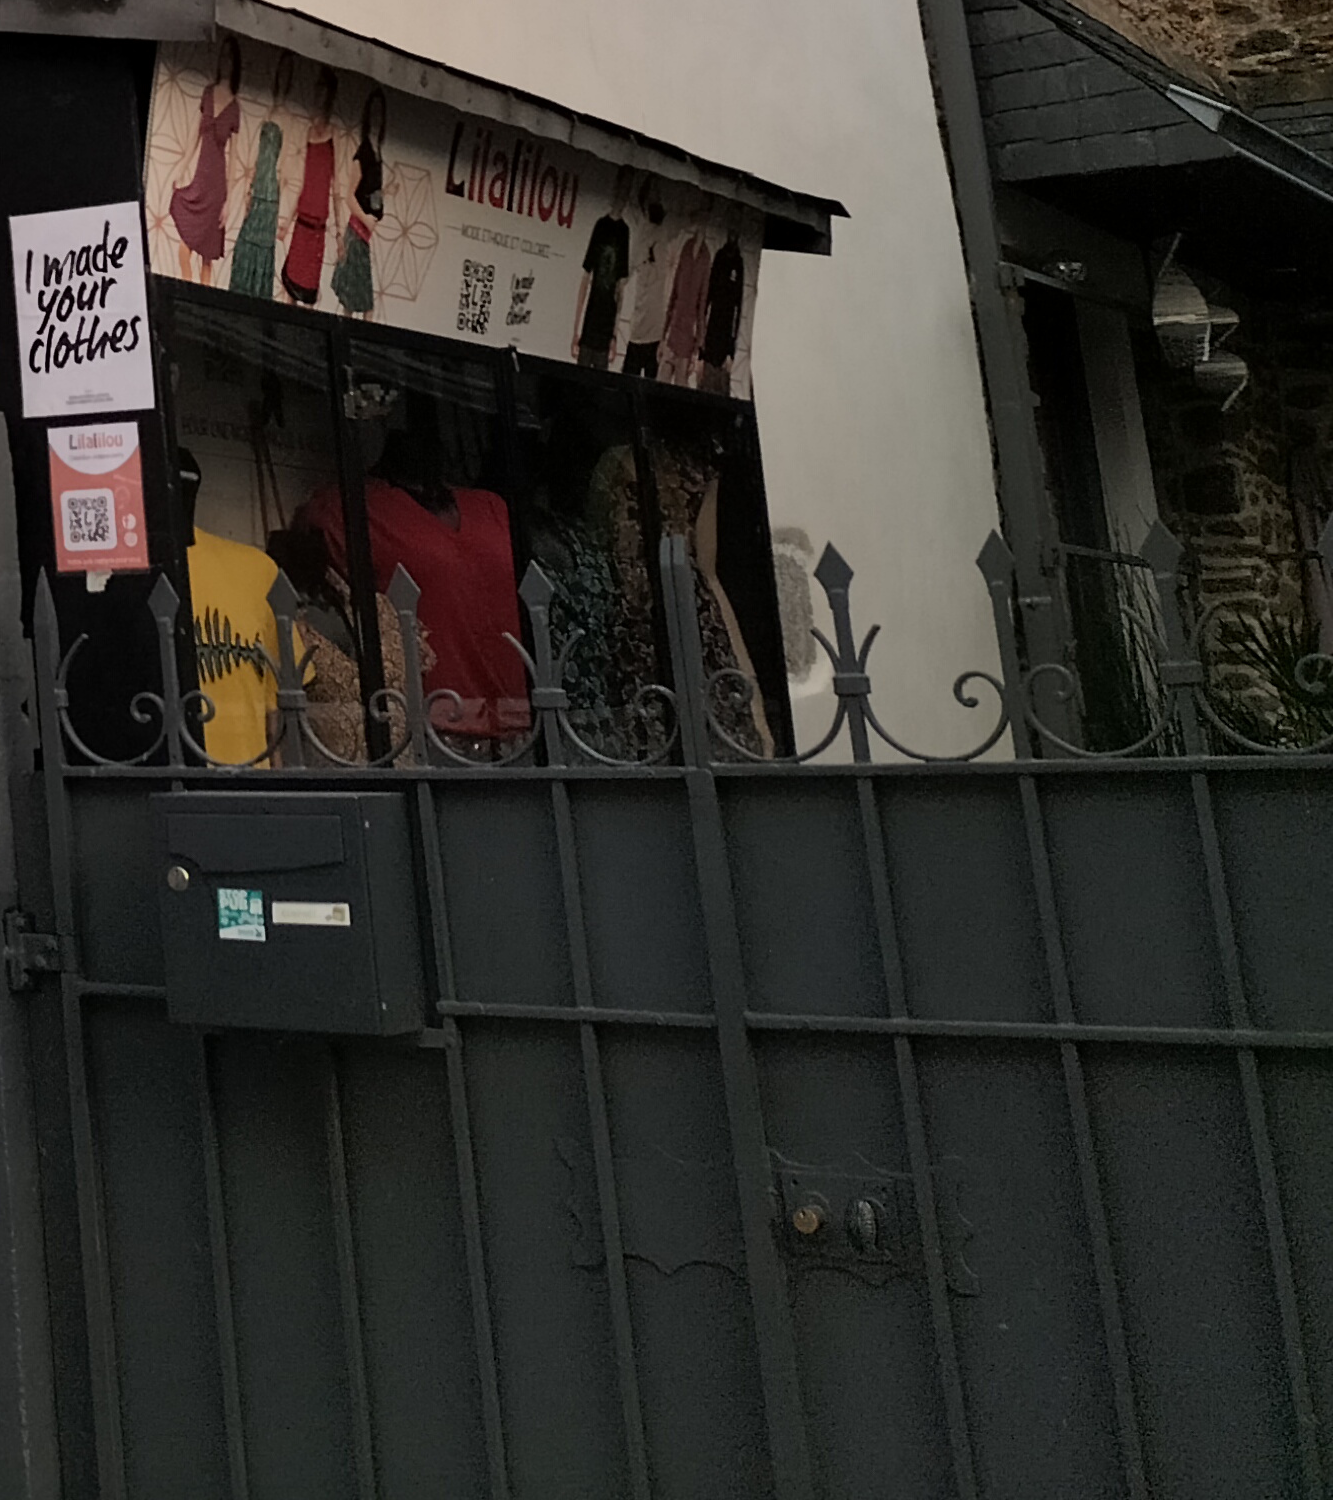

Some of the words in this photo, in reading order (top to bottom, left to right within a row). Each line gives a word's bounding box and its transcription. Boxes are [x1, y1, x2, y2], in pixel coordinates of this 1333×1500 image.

[445, 121, 580, 229] Lilalilou
[25, 249, 34, 294] I
[43, 220, 129, 288] made
[36, 275, 118, 336] your
[29, 315, 142, 374] clothes
[69, 432, 124, 451] Lilalilou
